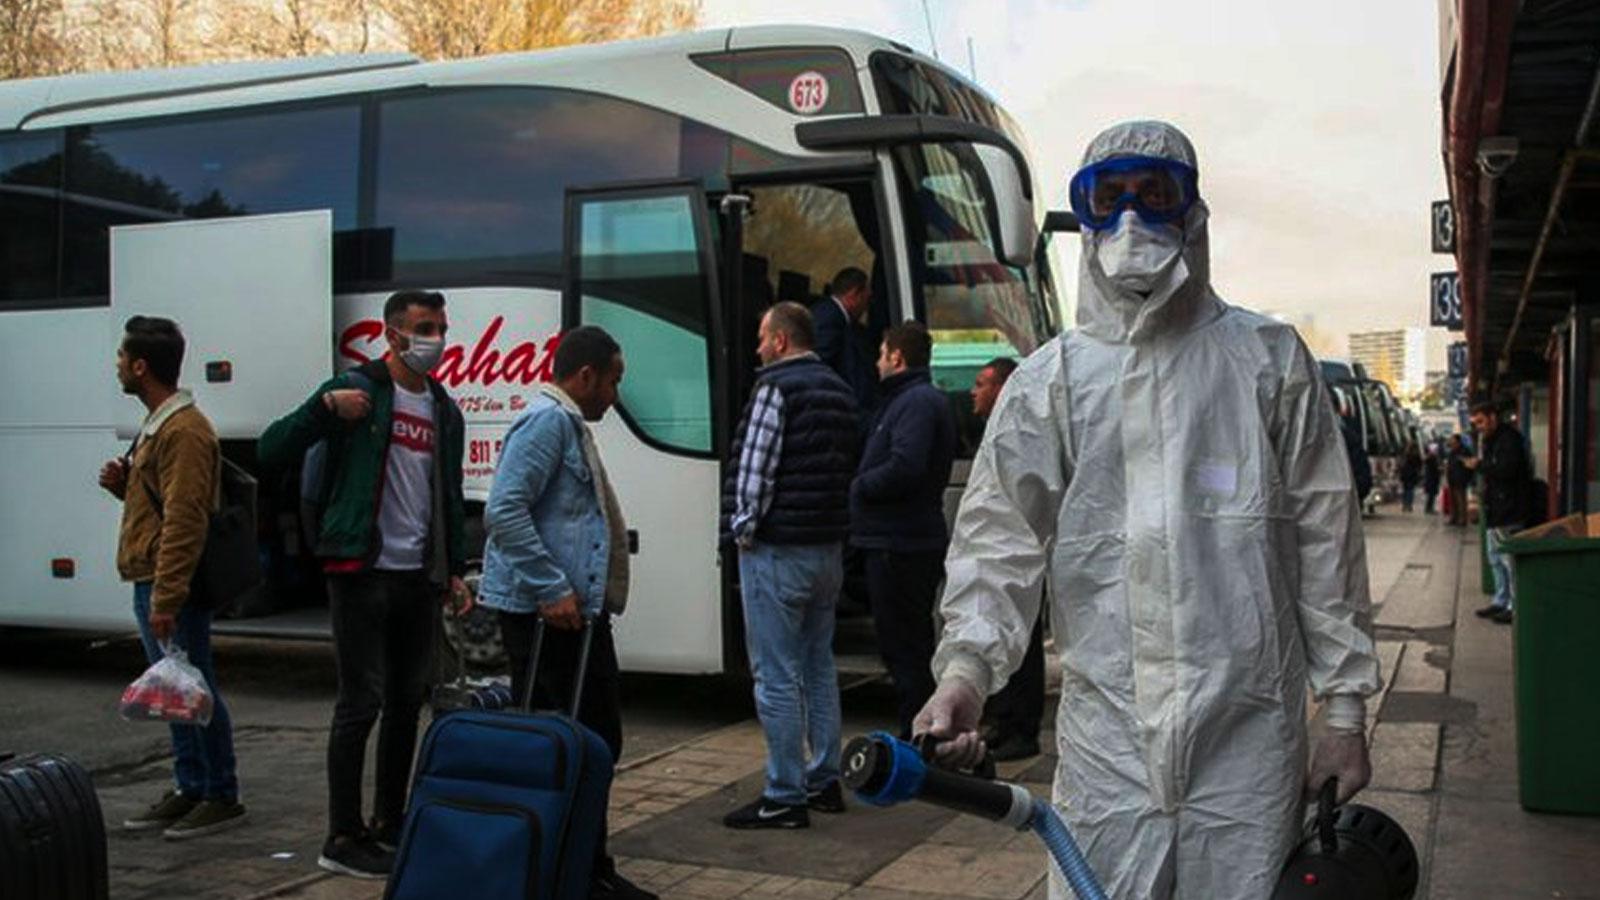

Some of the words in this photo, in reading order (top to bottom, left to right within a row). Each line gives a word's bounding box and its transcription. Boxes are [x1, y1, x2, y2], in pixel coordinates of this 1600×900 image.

[794, 79, 823, 107] 673
[1433, 203, 1455, 247] 13
[470, 440, 490, 464] 811
